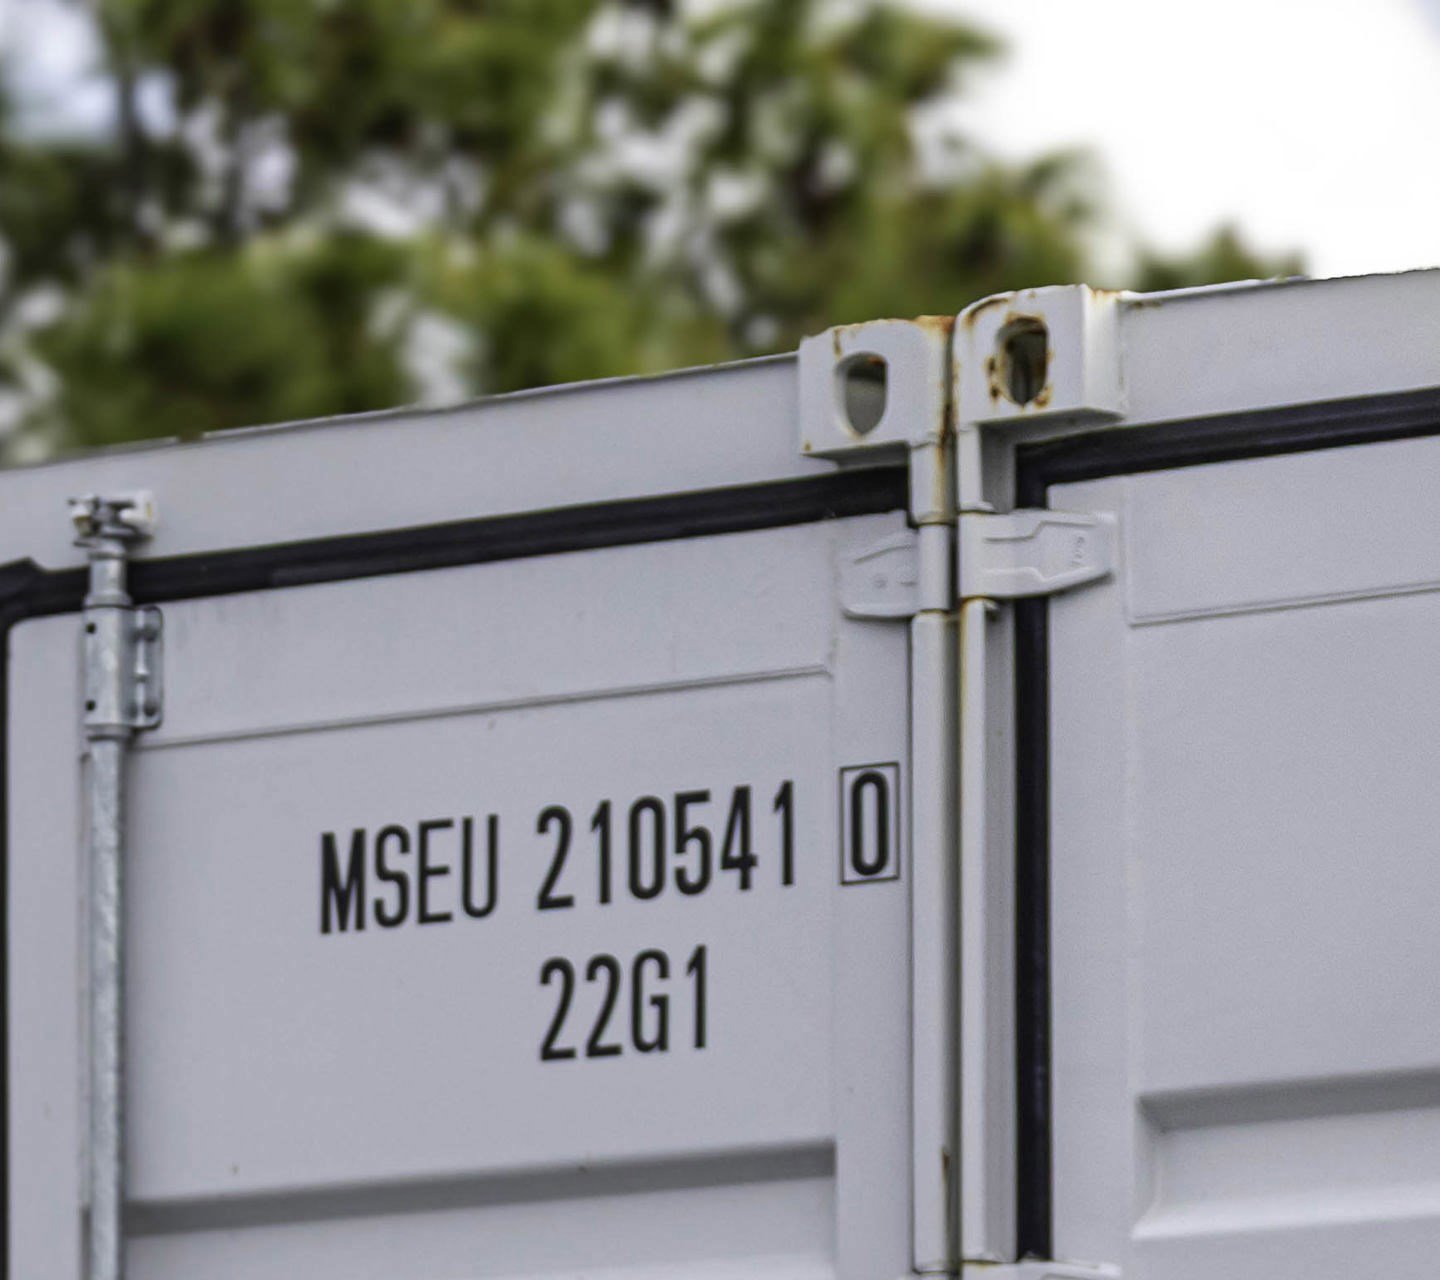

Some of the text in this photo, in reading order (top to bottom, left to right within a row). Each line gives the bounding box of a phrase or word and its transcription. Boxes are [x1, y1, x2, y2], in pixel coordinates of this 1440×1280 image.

[320, 769, 891, 935] MSEU 210541 0
[540, 945, 706, 1062] 22G1
